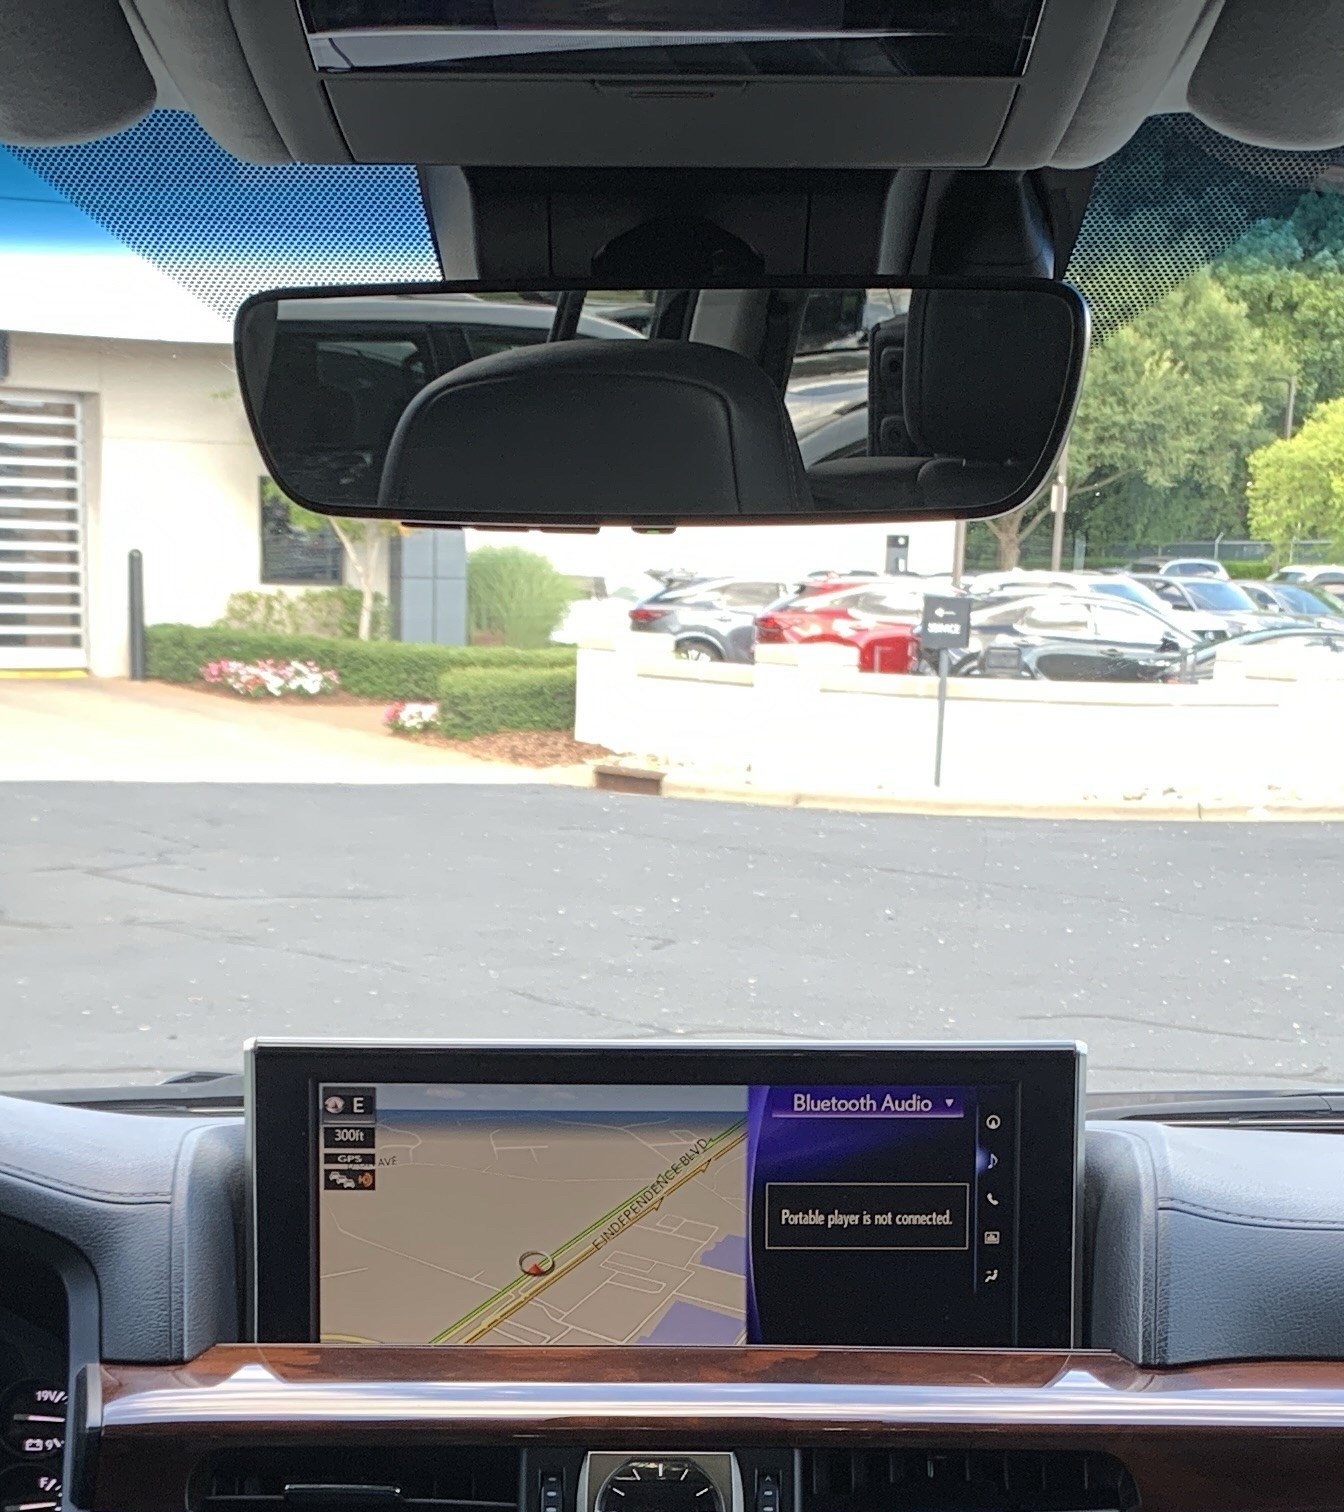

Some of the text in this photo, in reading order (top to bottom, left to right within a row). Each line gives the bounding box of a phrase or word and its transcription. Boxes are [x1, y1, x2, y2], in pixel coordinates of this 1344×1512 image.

[352, 1096, 365, 1114] E
[793, 1093, 933, 1112] Bluetooth Audio
[334, 1128, 364, 1142] 300ft
[337, 1154, 363, 1163] GPS
[600, 1162, 682, 1244] INDEPENDENCE
[679, 1138, 708, 1166] BLVD
[781, 1209, 953, 1228] Portable player is not connected.
